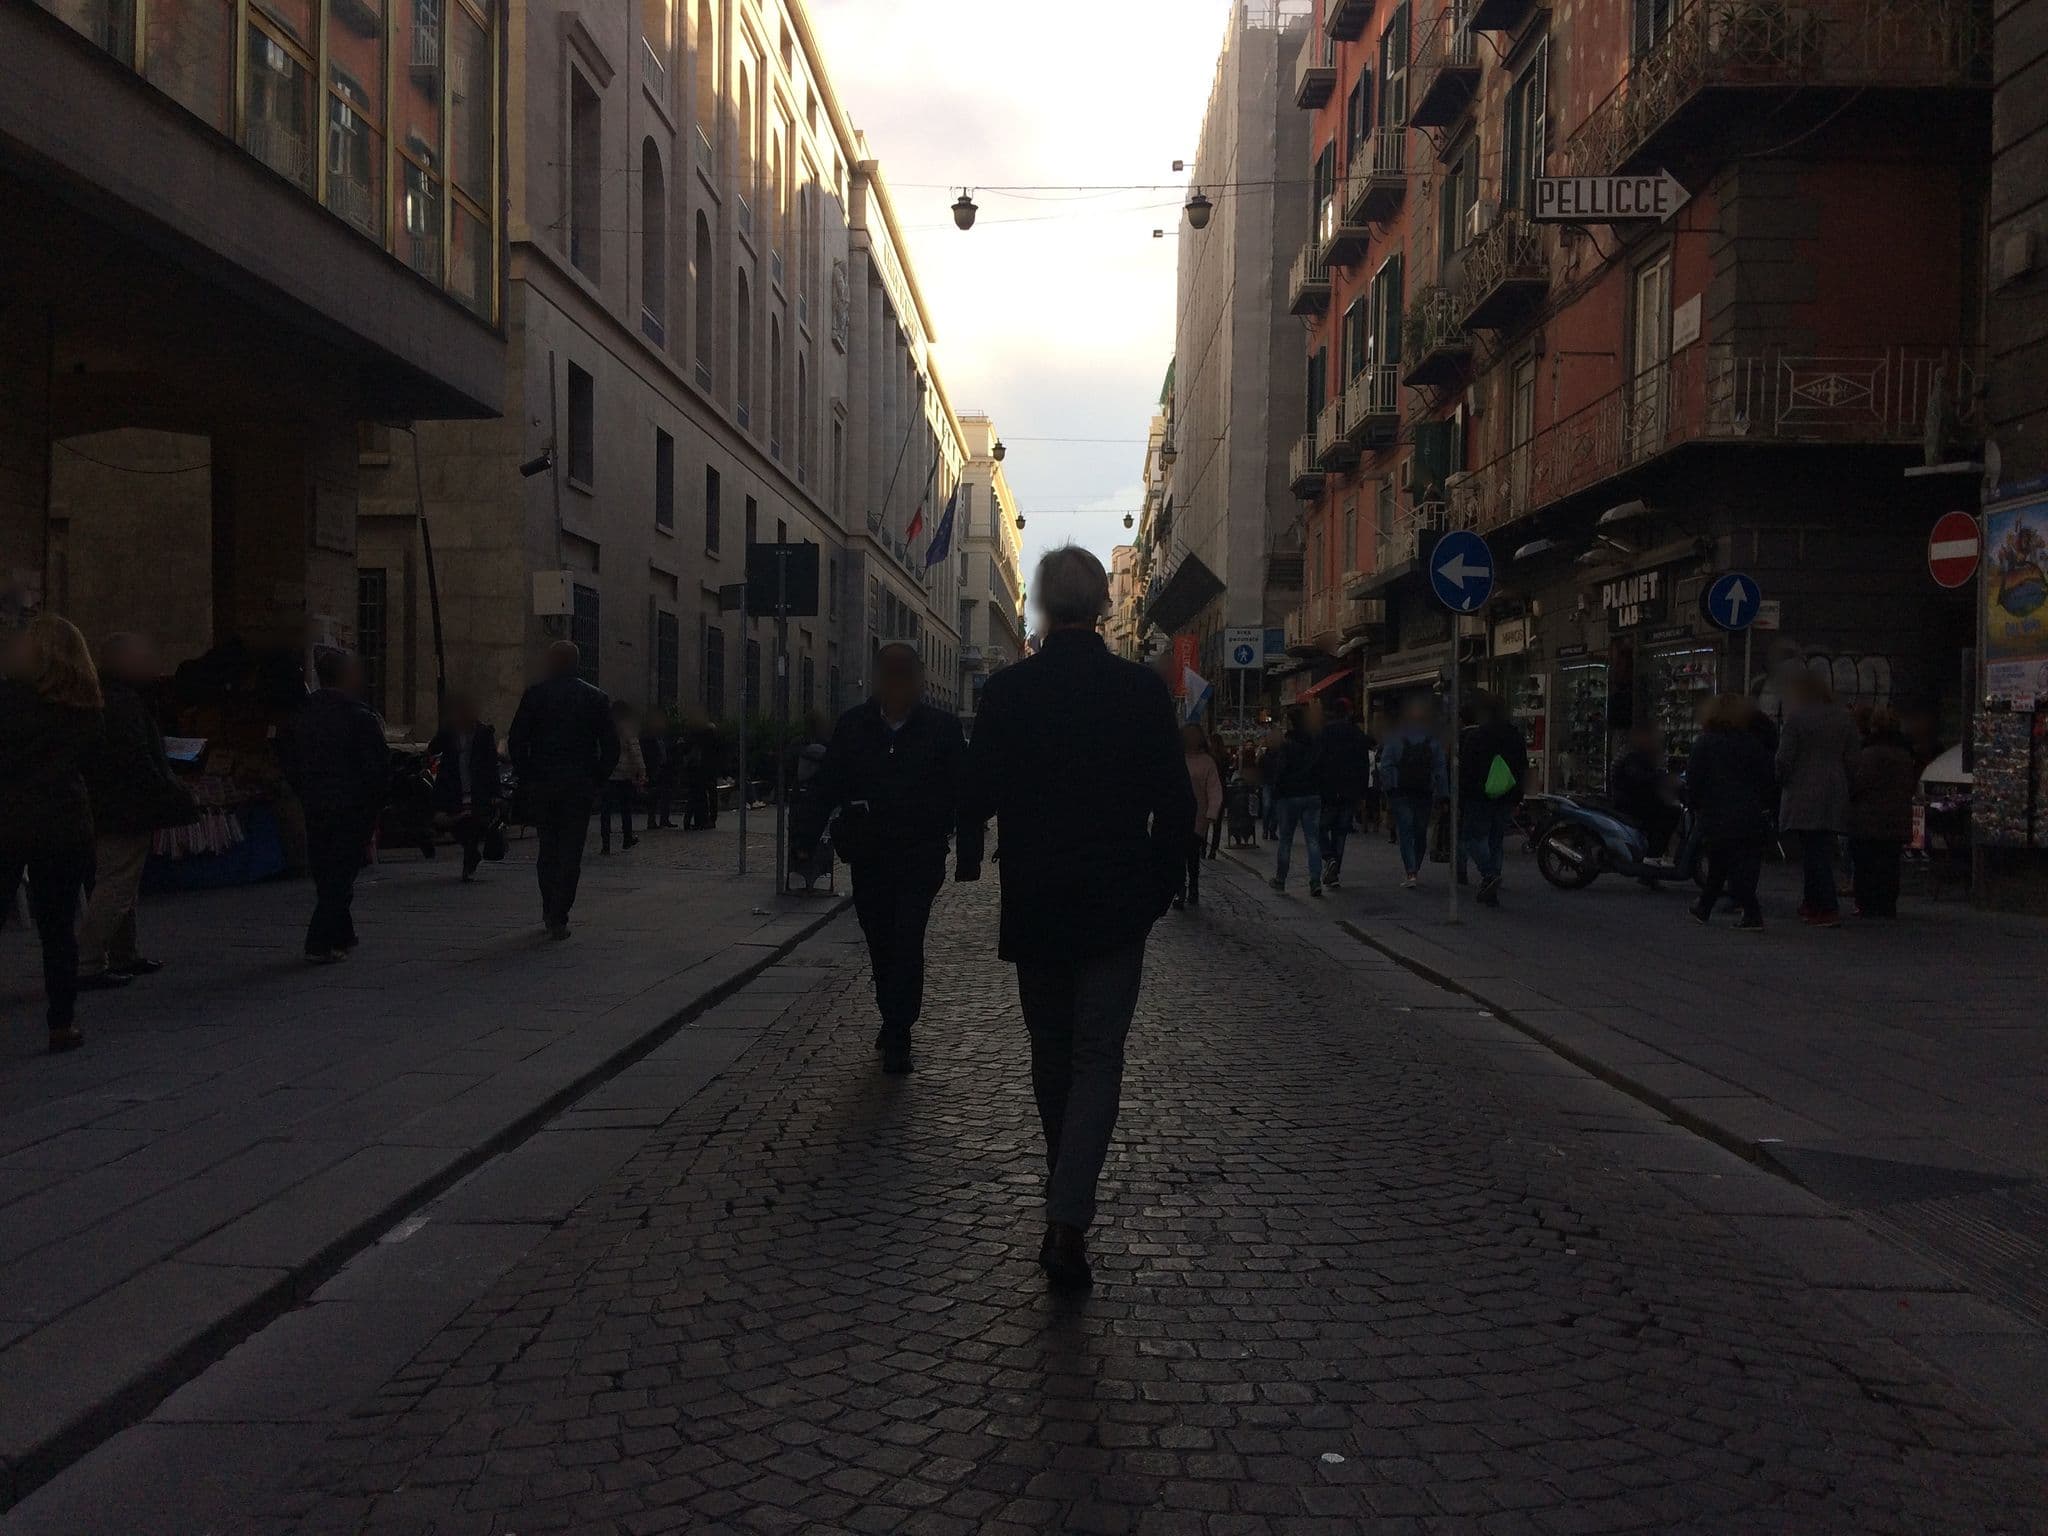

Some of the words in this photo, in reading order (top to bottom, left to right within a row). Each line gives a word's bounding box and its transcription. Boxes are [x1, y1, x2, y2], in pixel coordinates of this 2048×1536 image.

[1538, 178, 1668, 215] PELLICCE
[1602, 571, 1659, 610] PLANET
[1618, 604, 1639, 628] LAB
